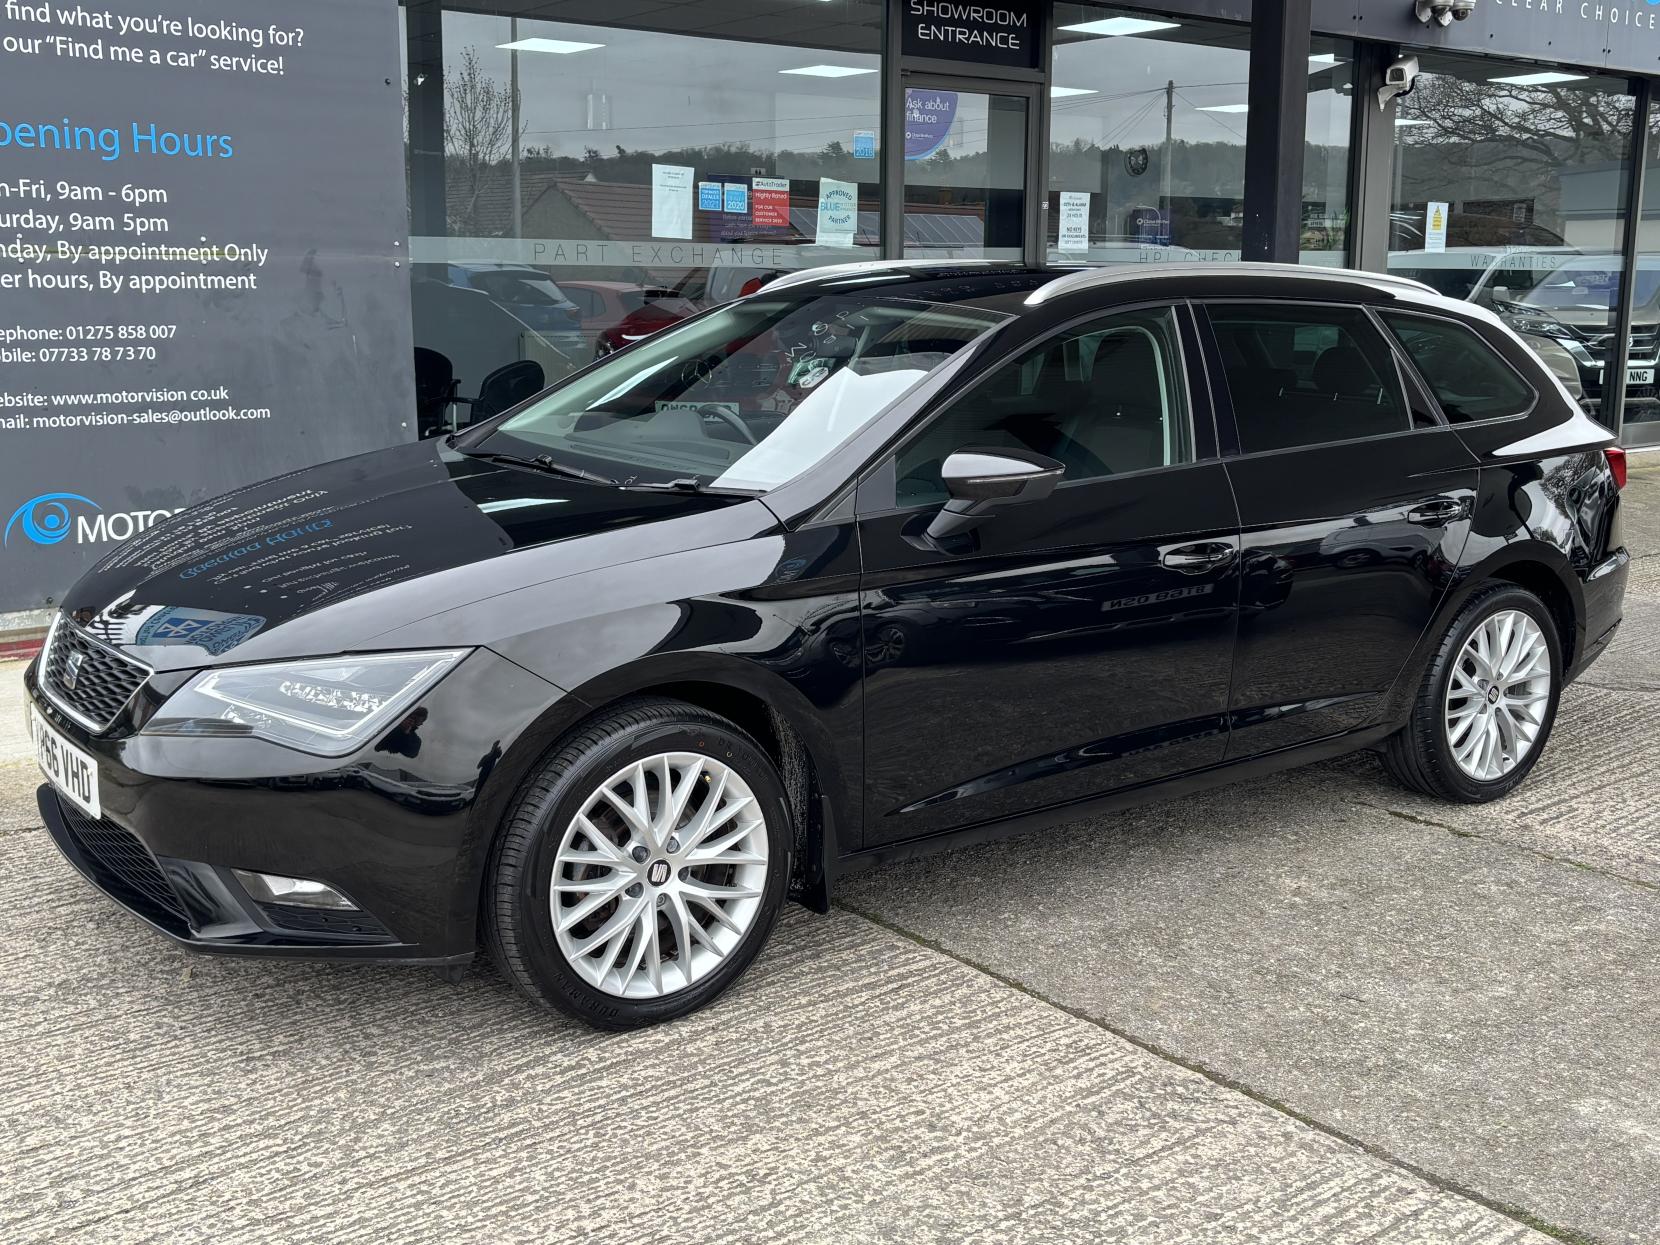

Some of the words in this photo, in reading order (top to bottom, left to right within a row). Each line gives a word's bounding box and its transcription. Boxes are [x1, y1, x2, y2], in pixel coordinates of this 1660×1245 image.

[5, 0, 50, 24] find
[57, 7, 112, 29] what
[118, 14, 182, 35] you’re
[188, 17, 263, 47] looking
[268, 25, 304, 47] for?
[911, 0, 1027, 27] SHOWROOM
[1496, 0, 1562, 14] EAR
[1580, 2, 1656, 29] CHOICE
[918, 24, 1020, 49] ENTRANCE
[3, 36, 42, 54] our
[110, 44, 143, 63] me
[149, 50, 160, 65] a
[210, 54, 284, 75] service!
[906, 97, 922, 109] Ask
[925, 99, 949, 111] about
[906, 111, 937, 123] finance
[132, 122, 234, 158] Hours
[56, 181, 103, 201] 9am
[121, 184, 168, 207] 6pm
[727, 201, 745, 210] 2020
[826, 190, 853, 201] APPROVED
[821, 202, 841, 211] BLUE
[69, 212, 115, 231] 9am
[123, 213, 169, 235] 5pm
[828, 214, 850, 225] PARTNER
[57, 240, 82, 263] By
[88, 242, 219, 264] appointment
[224, 243, 268, 267] Only
[534, 243, 609, 262] PART
[632, 244, 783, 266] EXCHANGE
[1471, 255, 1557, 269] WARANTIES
[0, 273, 22, 289] er
[28, 268, 94, 291] hours,
[100, 270, 124, 293] By
[129, 271, 257, 293] appointment
[66, 325, 114, 340] 01275
[118, 325, 147, 339] 858
[149, 325, 177, 339] 007
[0, 348, 36, 363] bile:
[39, 348, 88, 362] 07733
[92, 347, 111, 361] 78
[1630, 371, 1648, 382] NNG
[33, 406, 271, 428] motorvision-sales@outlook.com
[77, 508, 187, 544] MOTO
[36, 718, 59, 778] P66
[61, 745, 91, 804] VHD
